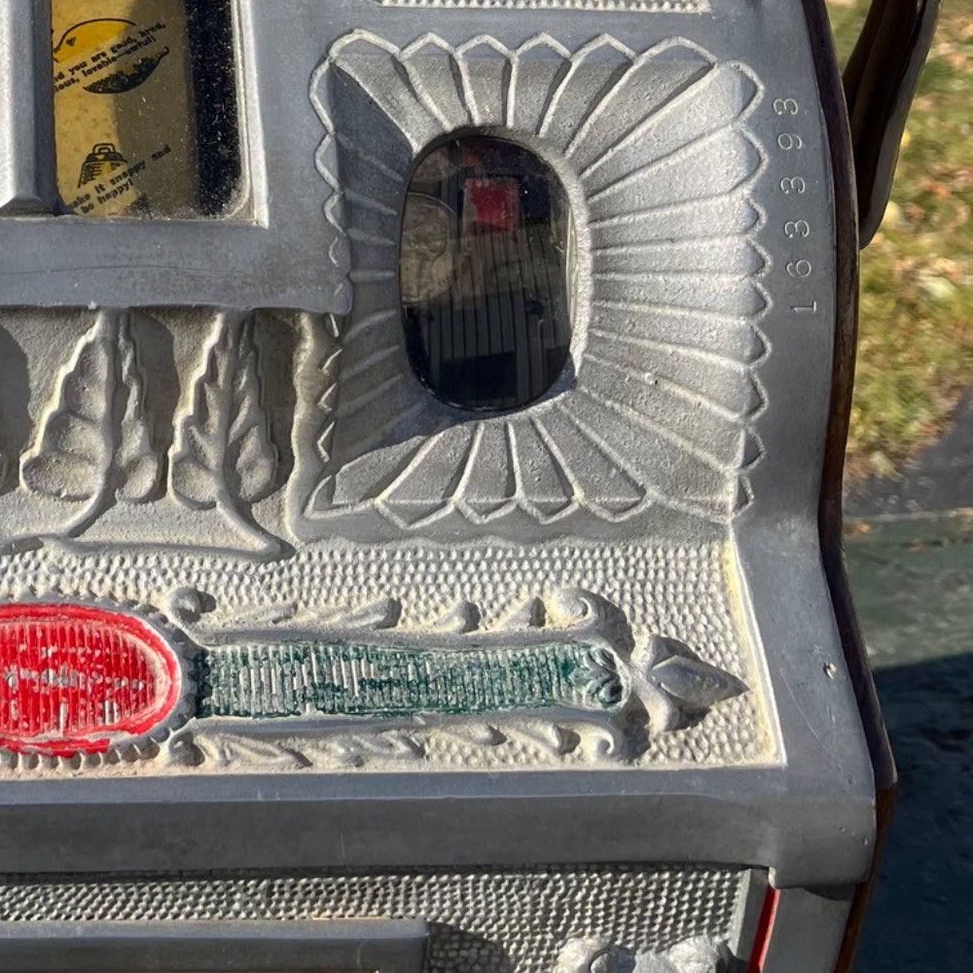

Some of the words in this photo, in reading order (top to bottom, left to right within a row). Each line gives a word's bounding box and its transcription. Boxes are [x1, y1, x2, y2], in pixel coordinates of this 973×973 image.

[68, 59, 88, 76] you
[90, 50, 108, 63] are
[93, 181, 107, 195] it
[109, 158, 147, 185] snappy
[150, 143, 173, 162] and
[80, 202, 96, 214] be
[772, 97, 818, 315] 163393
